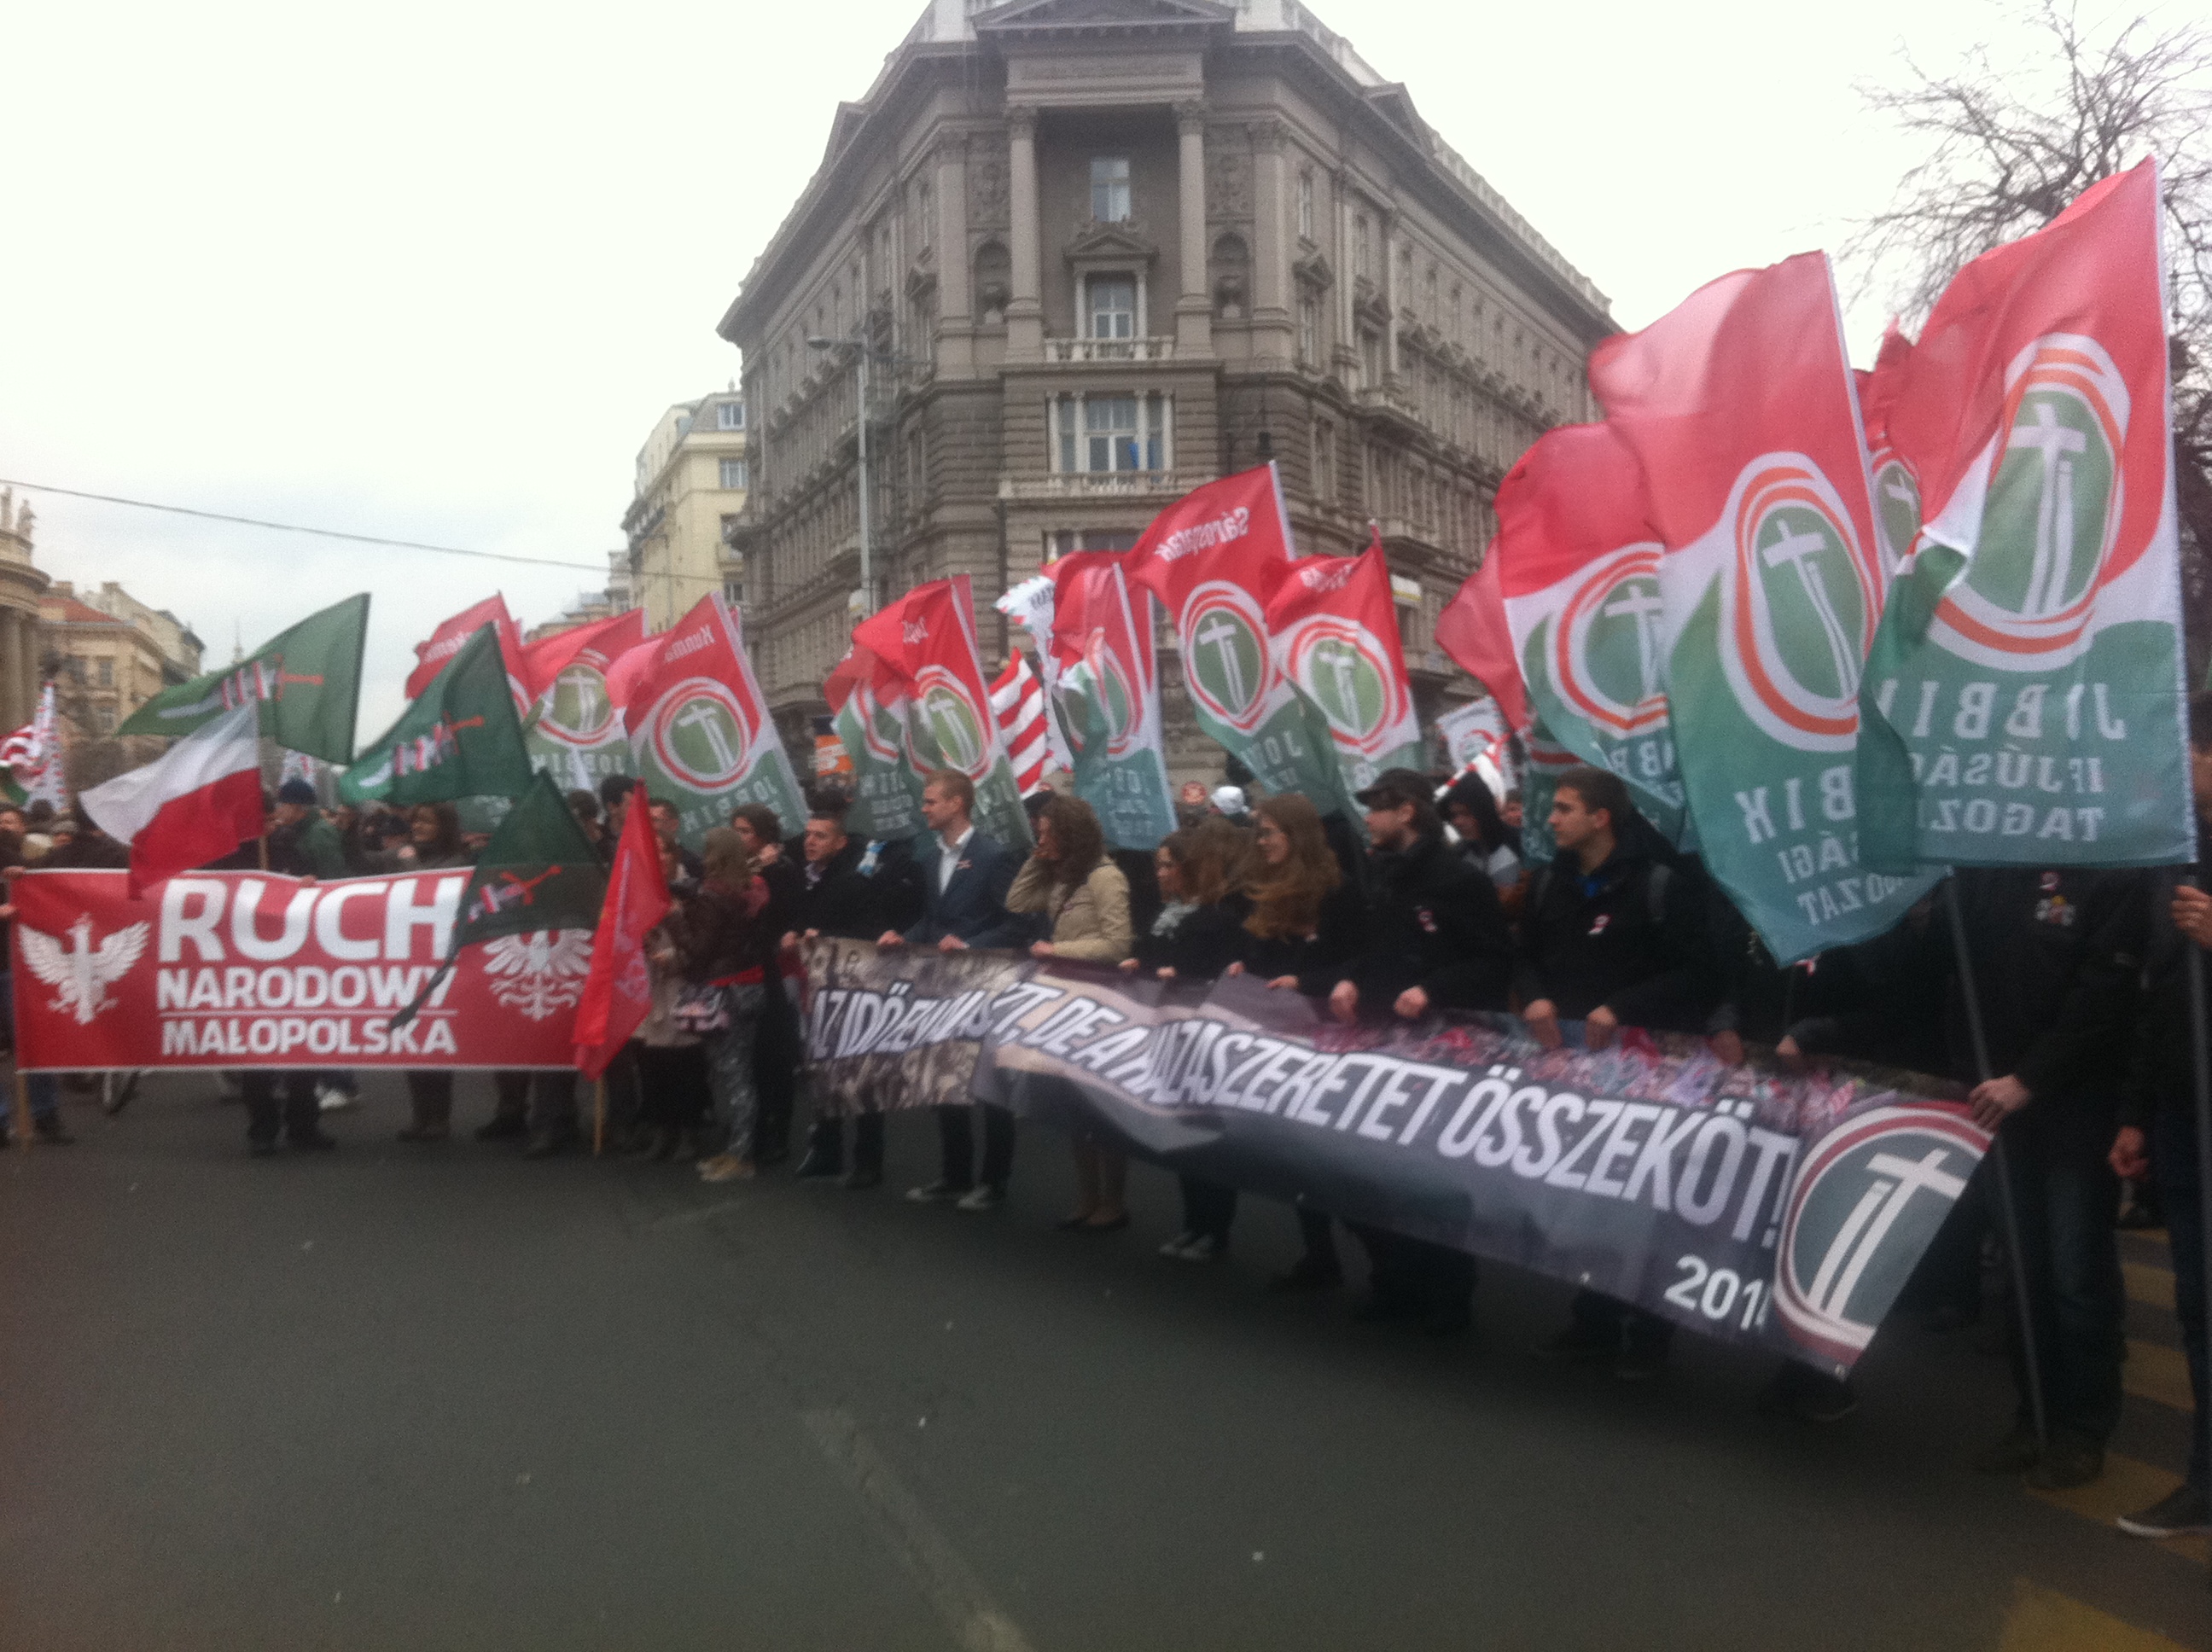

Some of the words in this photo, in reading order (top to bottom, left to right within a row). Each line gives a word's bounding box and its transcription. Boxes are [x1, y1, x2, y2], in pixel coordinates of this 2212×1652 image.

[159, 875, 467, 963] RUCH
[156, 964, 458, 1009] NARODOWY
[161, 1017, 458, 1056] MAŁOPOLSKA
[1022, 997, 1125, 1055] DE
[1069, 1025, 1150, 1070] A
[1436, 1063, 1801, 1249] ÖSSZEKÖT!
